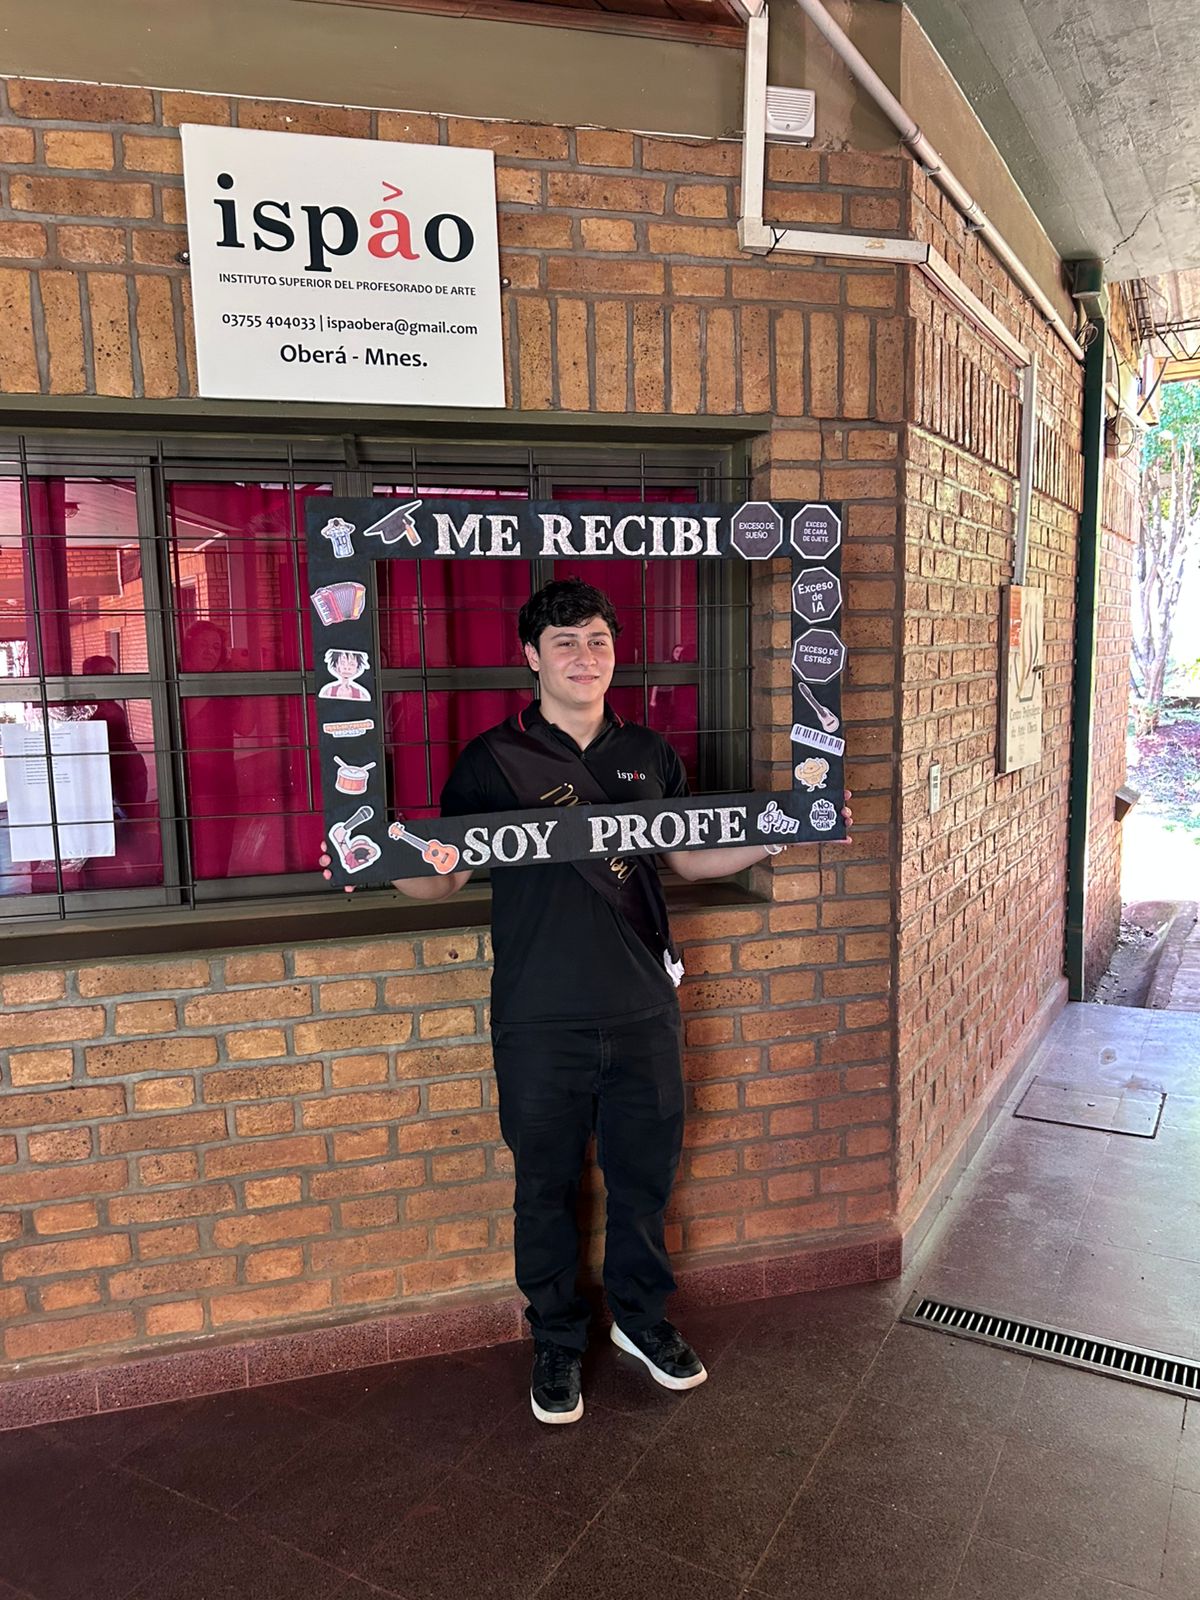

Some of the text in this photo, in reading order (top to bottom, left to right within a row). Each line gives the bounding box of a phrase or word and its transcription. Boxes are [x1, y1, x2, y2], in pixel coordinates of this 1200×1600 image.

[219, 273, 476, 296] INSTITUTO SUPERIOR DEL PROFESORADO DE ARTE
[222, 313, 262, 328] 03755
[265, 316, 316, 331] 404033
[327, 316, 478, 336] ispaobera@gmail.com
[280, 343, 347, 364] Oberá
[365, 347, 428, 367] Mnes.
[739, 522, 775, 530] EXCESO DE
[811, 528, 828, 536] CARA
[432, 513, 722, 556] ME RECIBI
[745, 530, 768, 539] SUEÑO
[797, 581, 834, 595] Exceso
[811, 592, 823, 601] de
[811, 601, 825, 613] IA
[799, 644, 839, 656] EXCESO DE
[803, 654, 832, 665] ESTRÉS
[817, 800, 830, 809] NO
[462, 806, 747, 866] SOY PROFE
